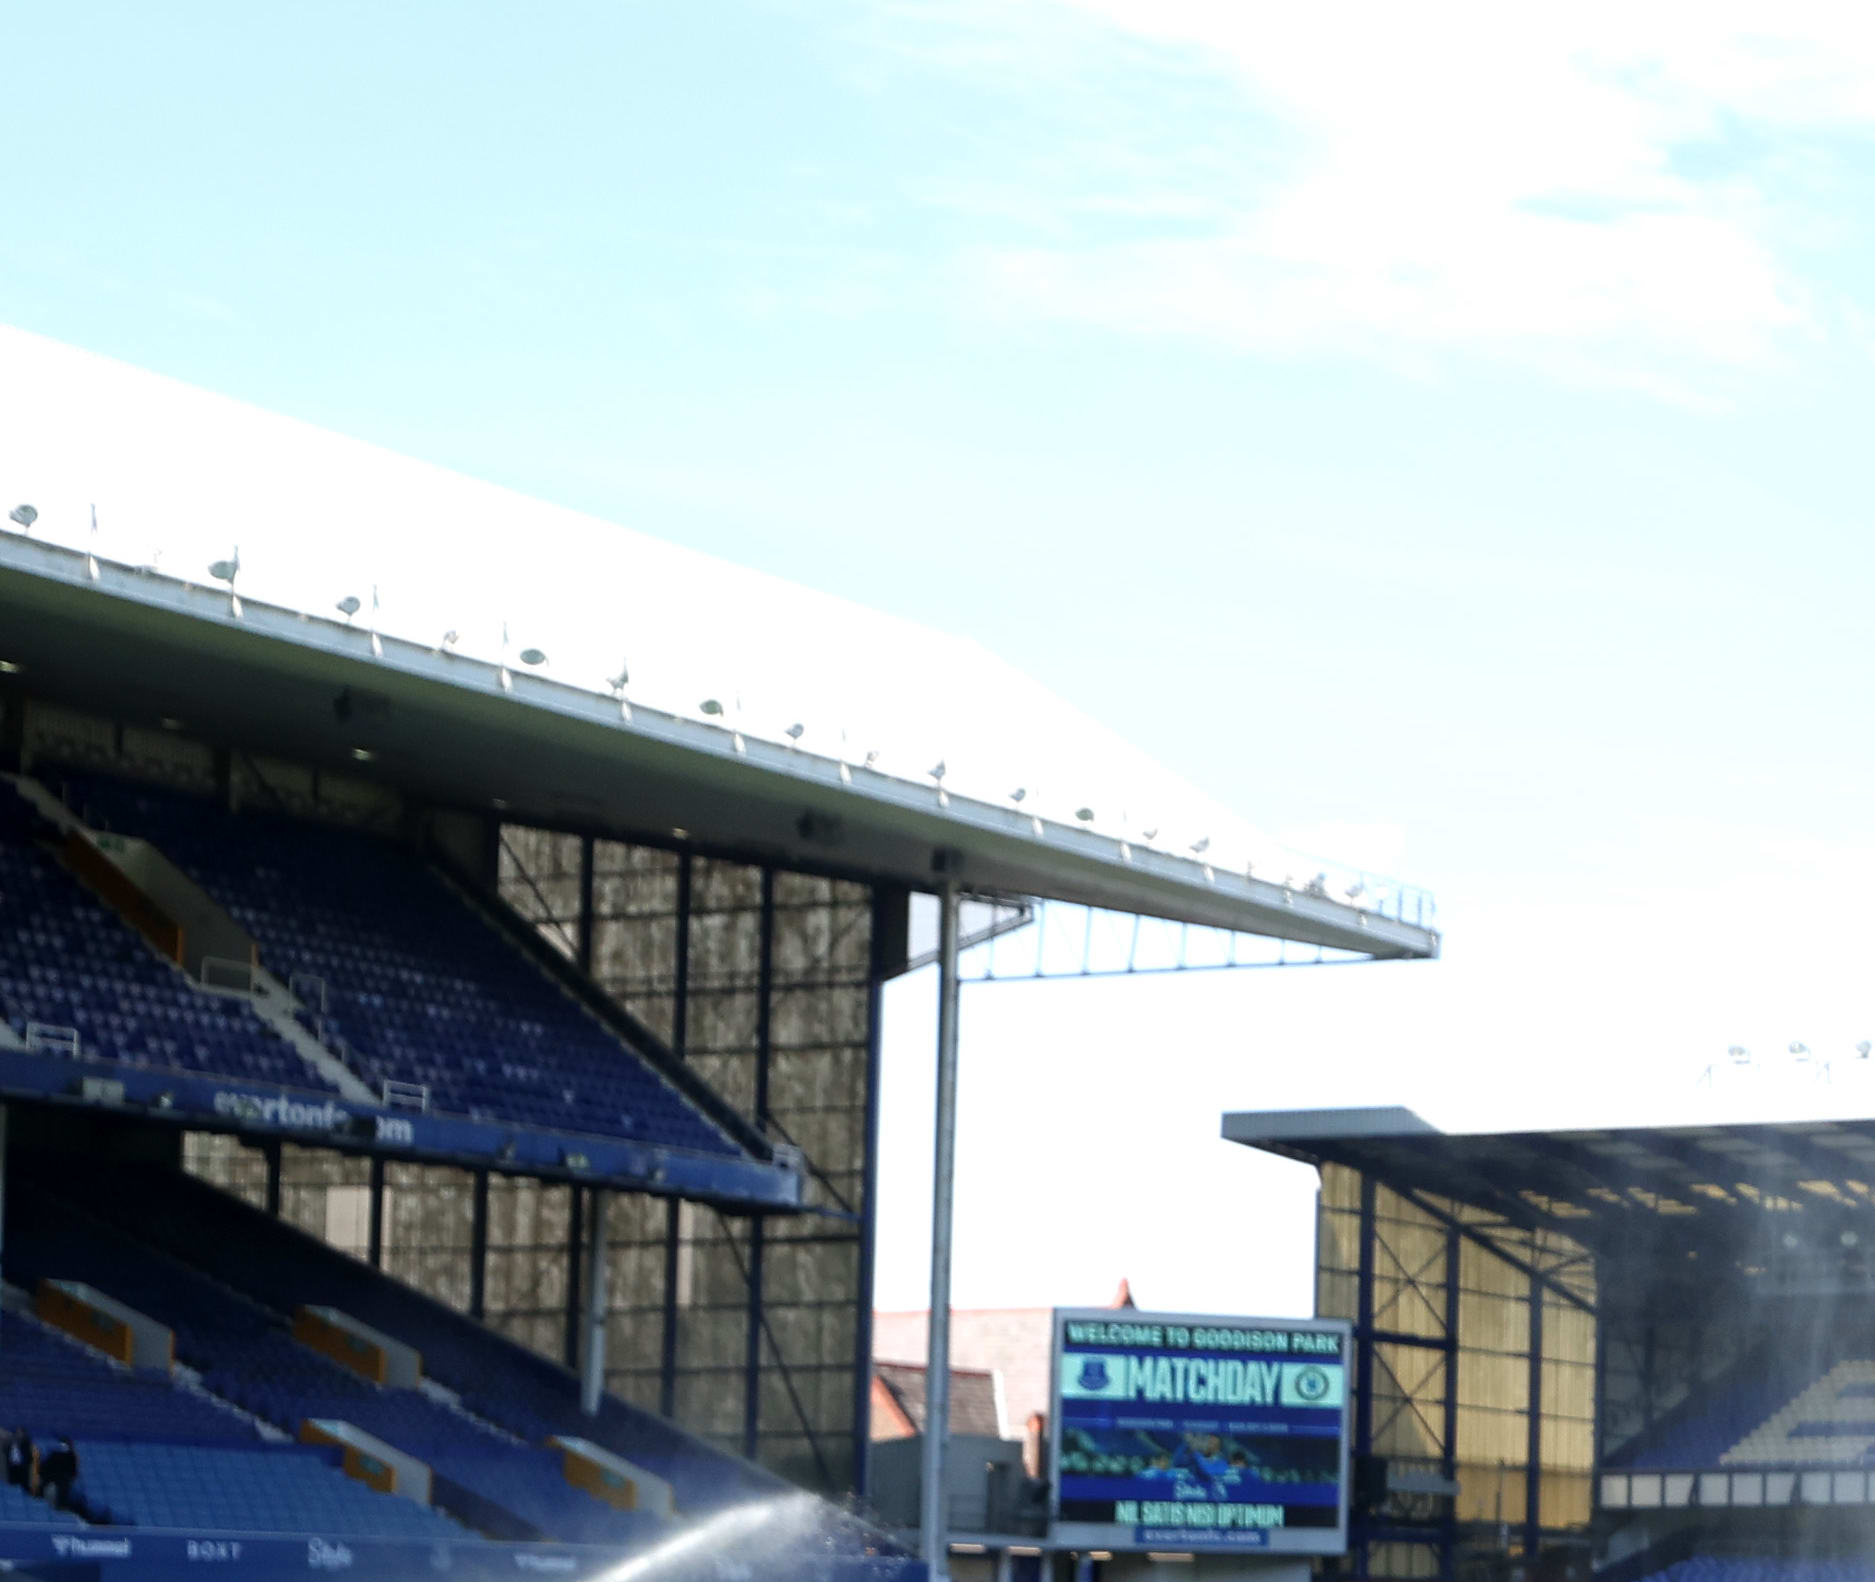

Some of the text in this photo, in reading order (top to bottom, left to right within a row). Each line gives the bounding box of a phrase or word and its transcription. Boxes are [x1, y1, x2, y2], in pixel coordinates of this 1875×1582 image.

[1068, 1322, 1338, 1353] WELCOME TO GOODISON PARK
[1129, 1355, 1281, 1406] MATCHDAY
